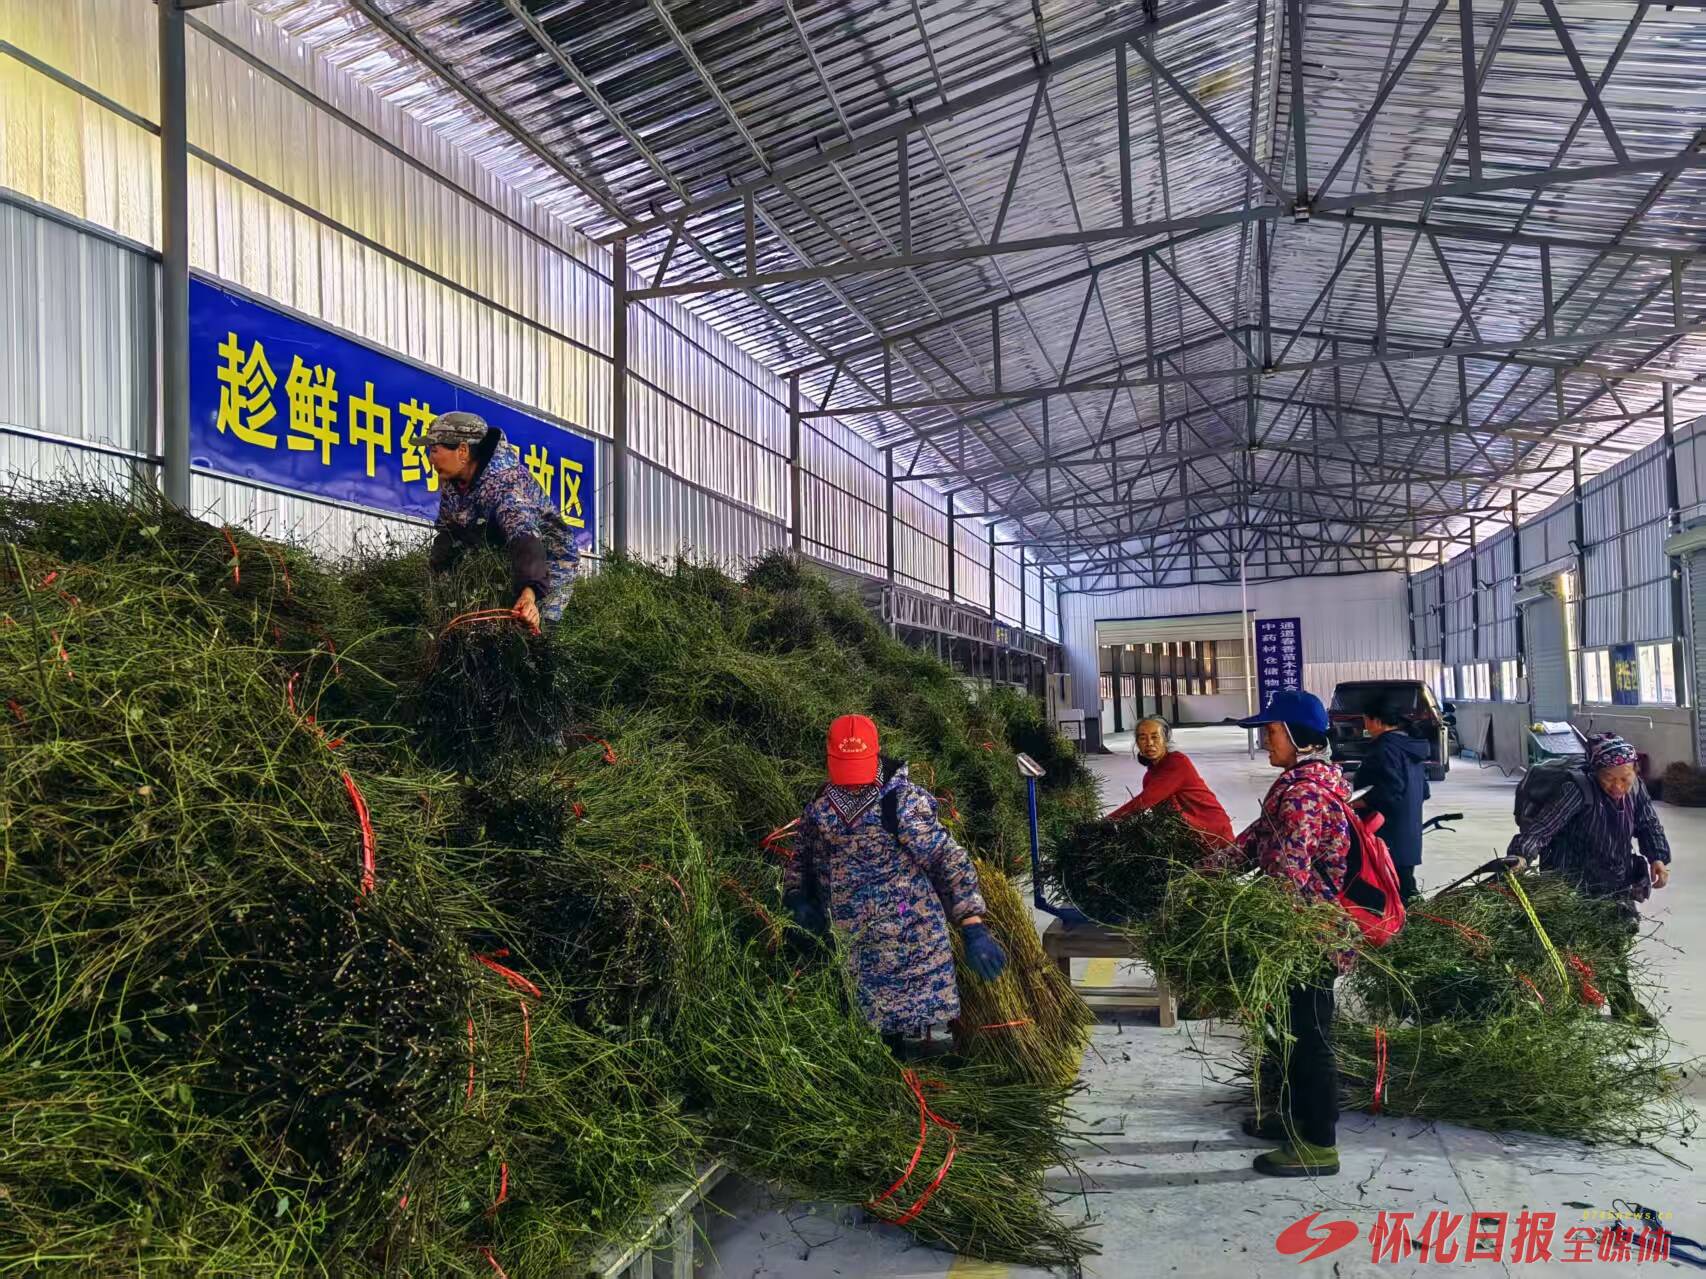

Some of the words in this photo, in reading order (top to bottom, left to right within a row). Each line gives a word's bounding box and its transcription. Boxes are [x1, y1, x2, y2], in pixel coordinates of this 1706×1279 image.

[216, 331, 585, 529] 趁鲜中药放区
